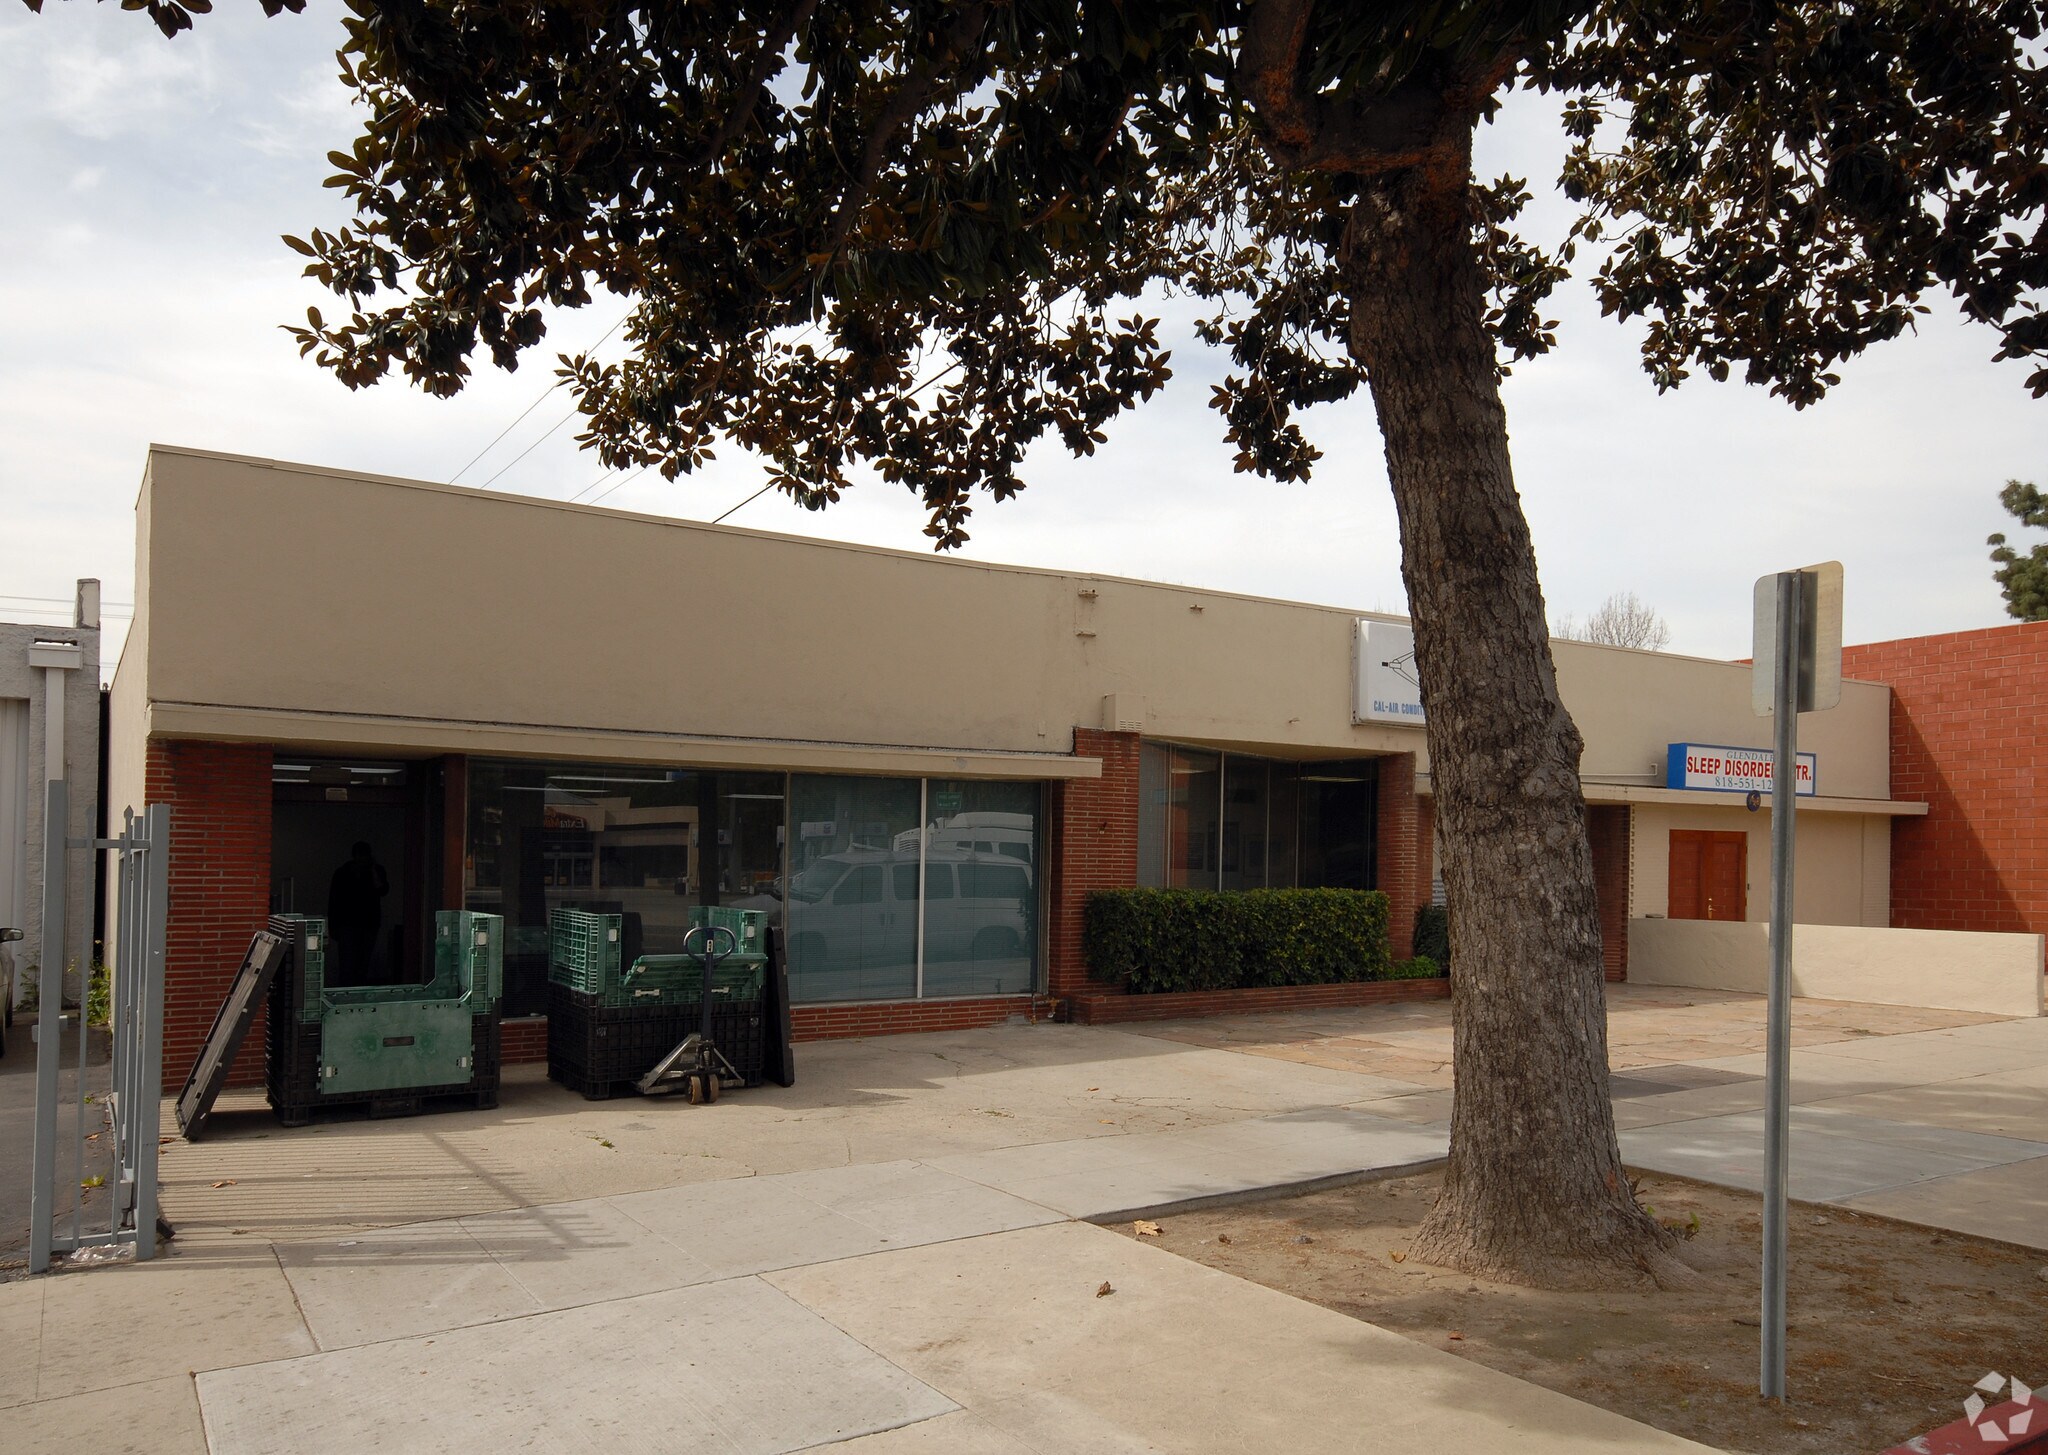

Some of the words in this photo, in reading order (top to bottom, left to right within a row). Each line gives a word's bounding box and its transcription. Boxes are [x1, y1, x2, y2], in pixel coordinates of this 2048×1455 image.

[1373, 700, 1399, 714] CAL-AIR
[1687, 756, 1721, 775] SLEEP
[1795, 764, 1812, 780] TR.
[1715, 776, 1772, 790] 818-551-12
